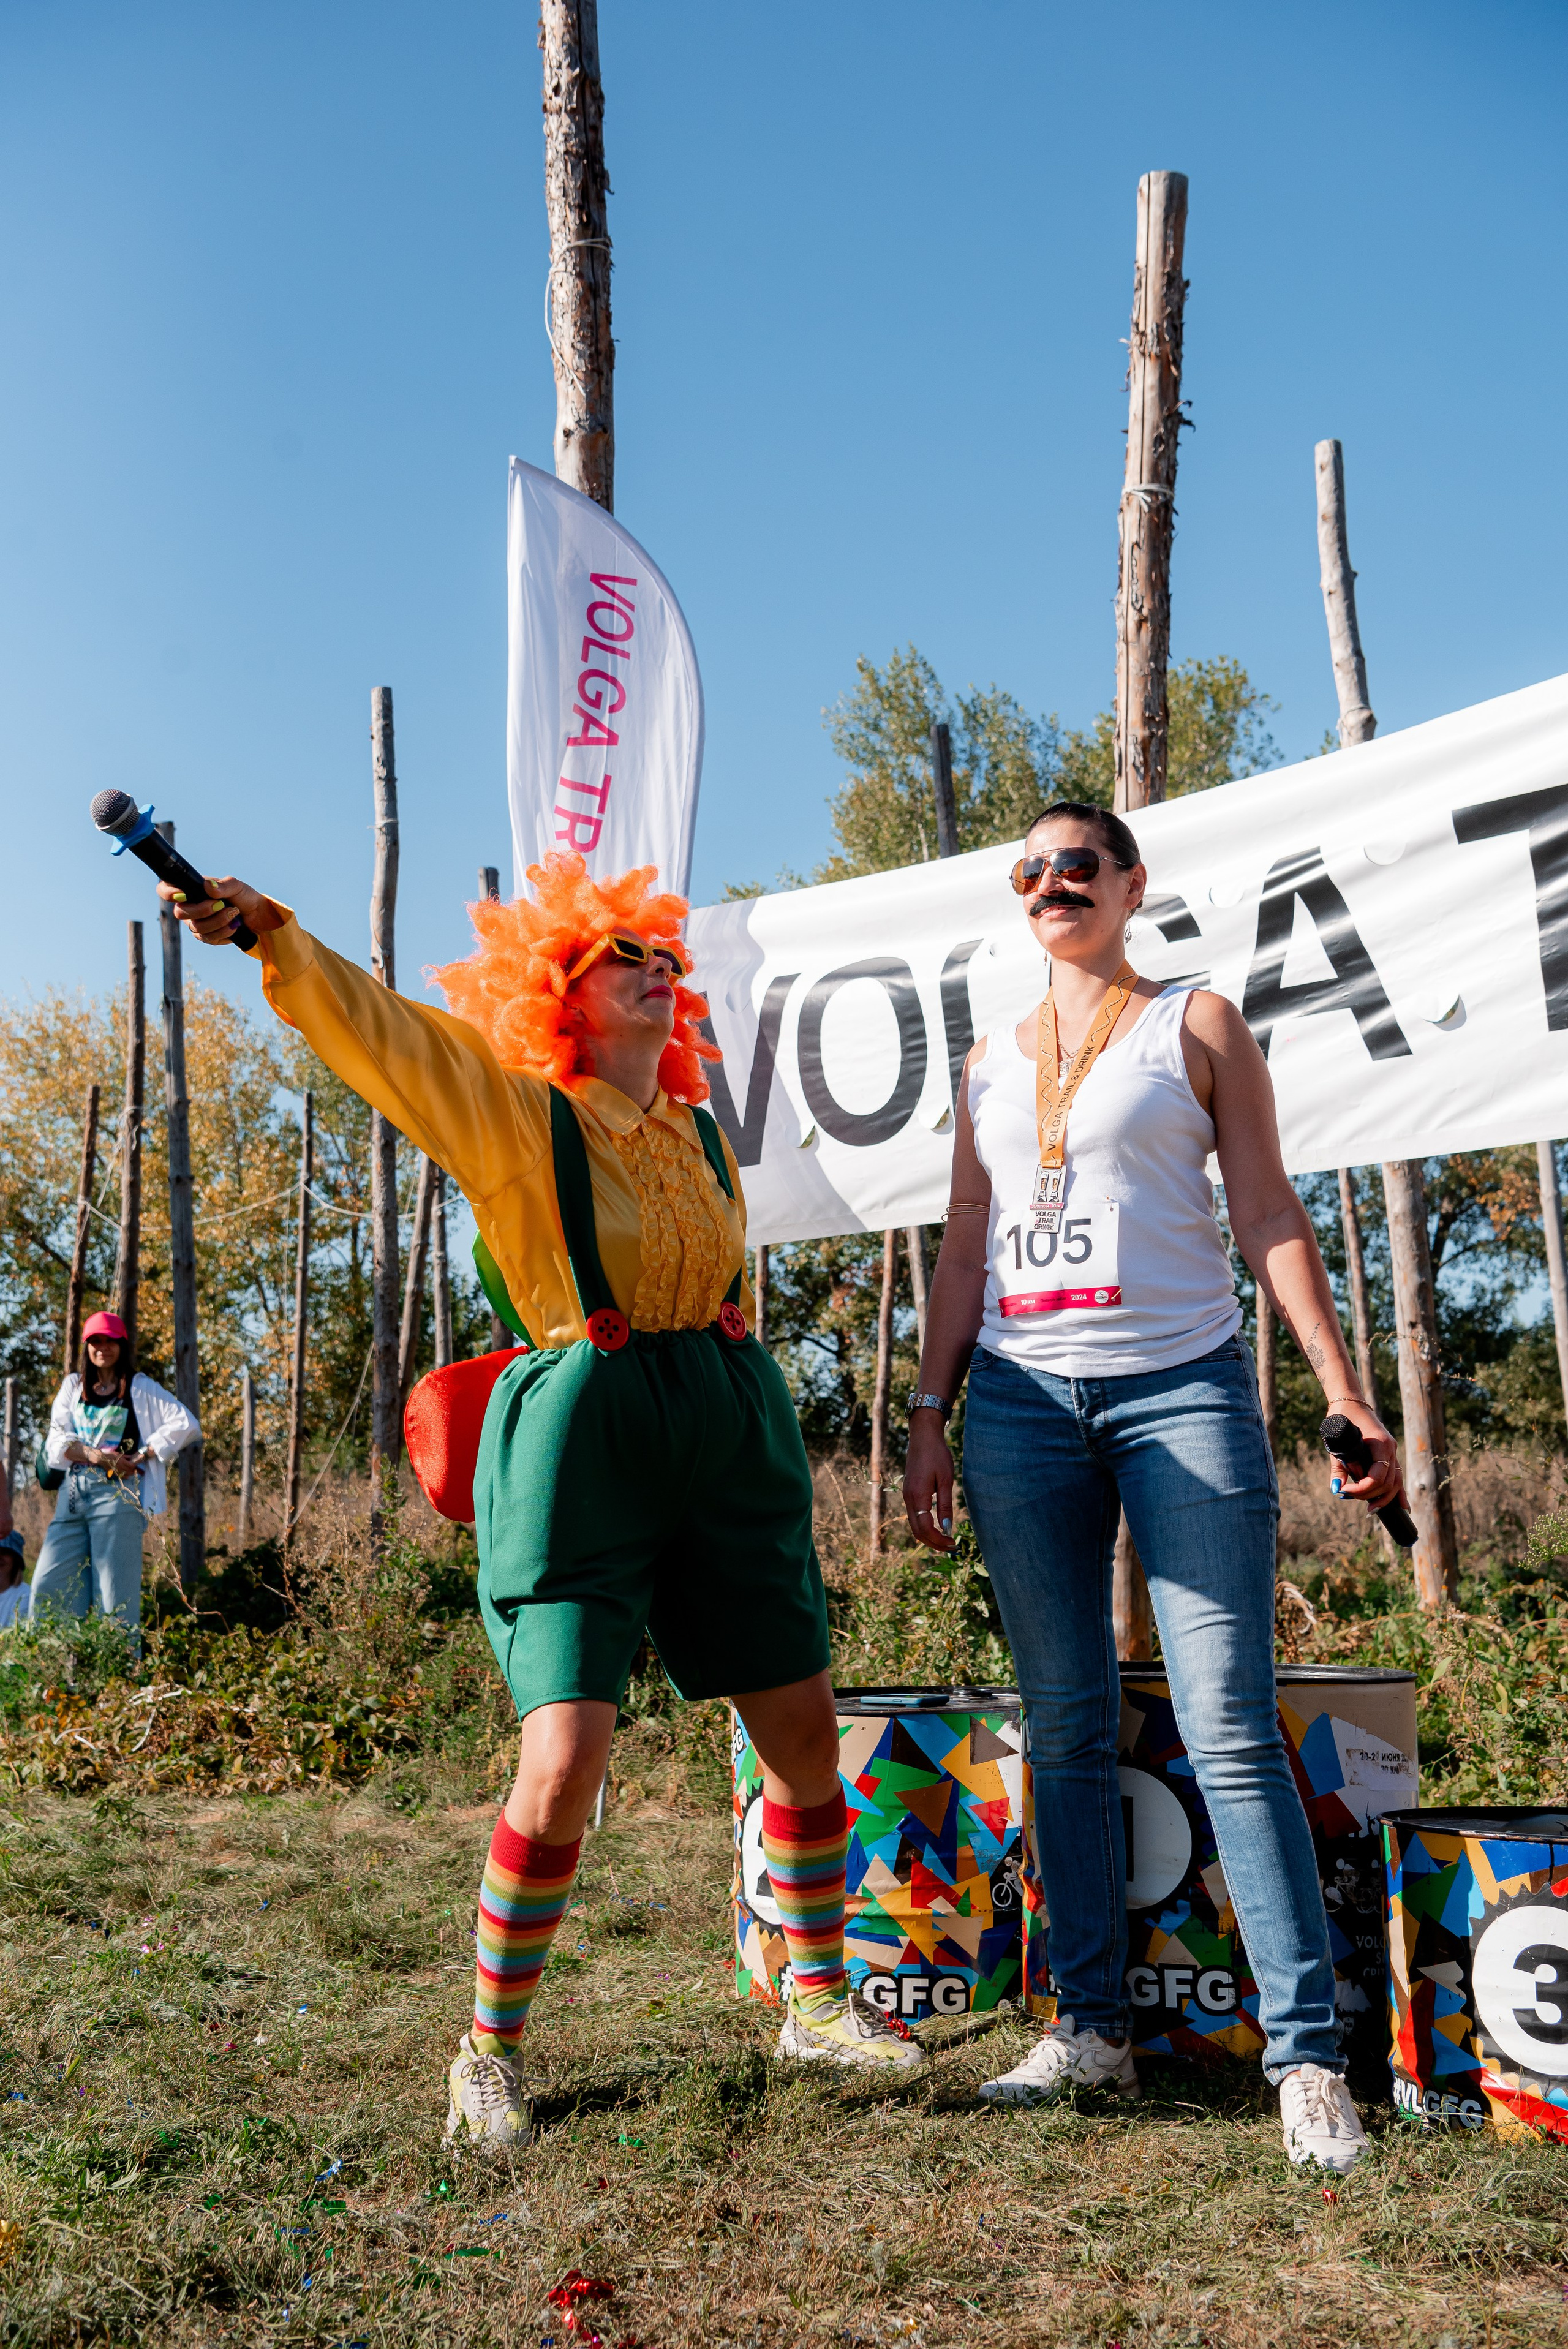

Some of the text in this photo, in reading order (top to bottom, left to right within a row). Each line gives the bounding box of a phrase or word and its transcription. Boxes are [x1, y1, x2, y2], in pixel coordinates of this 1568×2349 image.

[567, 573, 638, 747] VOLGA
[1047, 1111, 1063, 1152] VOLGA
[1058, 1082, 1076, 1110] TRAIL
[1074, 1046, 1096, 1073] DRINK
[1006, 1218, 1093, 1270] 105
[1381, 1752, 1400, 1762] ИЮНЯ
[1512, 1944, 1568, 2045] 3
